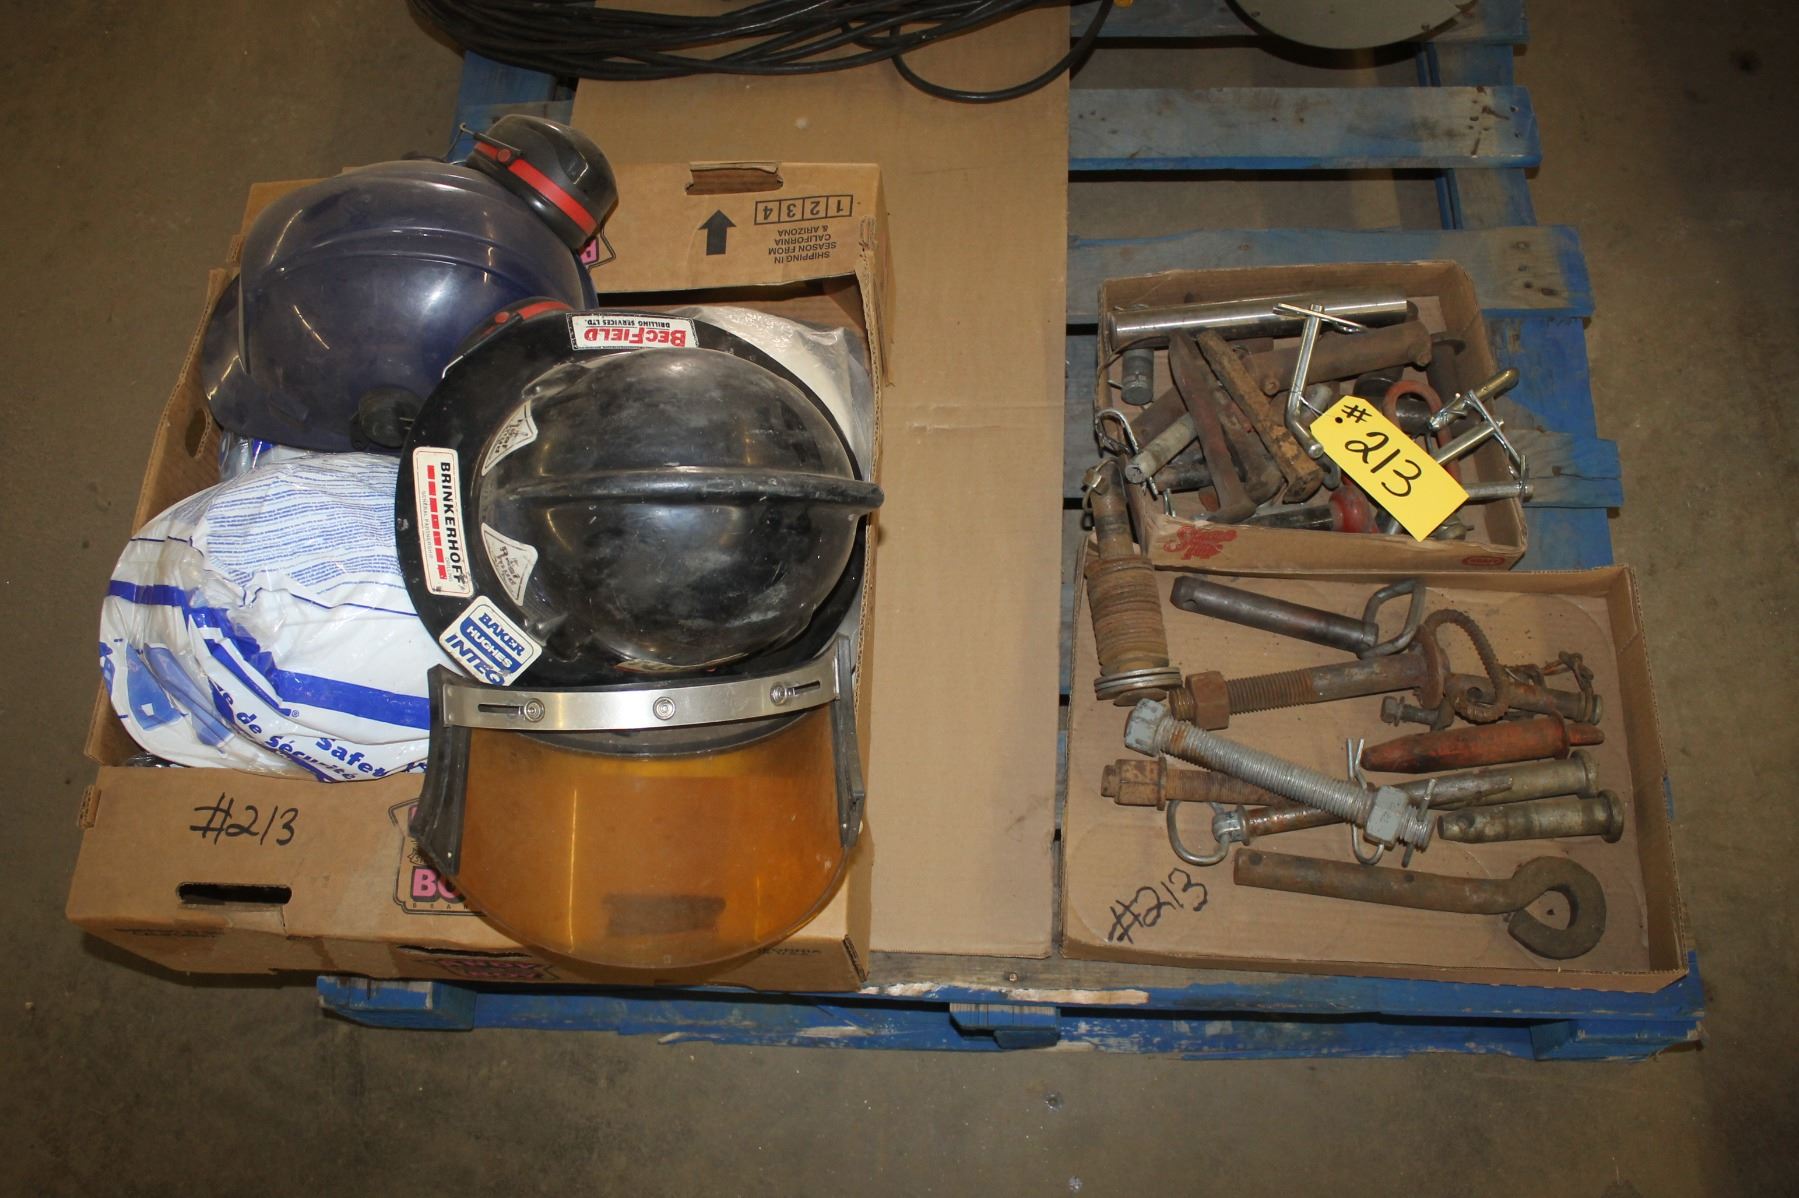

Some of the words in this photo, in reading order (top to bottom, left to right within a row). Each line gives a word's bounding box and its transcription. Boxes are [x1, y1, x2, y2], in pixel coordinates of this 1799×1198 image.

[763, 206, 773, 220] 4
[787, 203, 797, 218] 3
[810, 201, 820, 215] 2
[836, 200, 844, 213] 1
[777, 226, 820, 237] ARIZONA
[822, 224, 829, 232] &
[774, 233, 831, 246] CALIFORNIA
[768, 246, 796, 256] FROM
[798, 241, 837, 252] SEASON
[774, 256, 785, 264] IN
[785, 251, 831, 263] SHIPPING
[603, 319, 636, 327] SERVICES
[637, 320, 671, 329] DRILLING
[1344, 432, 1422, 498] 213
[440, 462, 466, 585] BRINKERHOFF
[479, 612, 525, 656] BAKER
[466, 626, 513, 668] HUGHES
[236, 712, 262, 734] de
[189, 792, 299, 846] #213
[1107, 867, 1208, 945] #213
